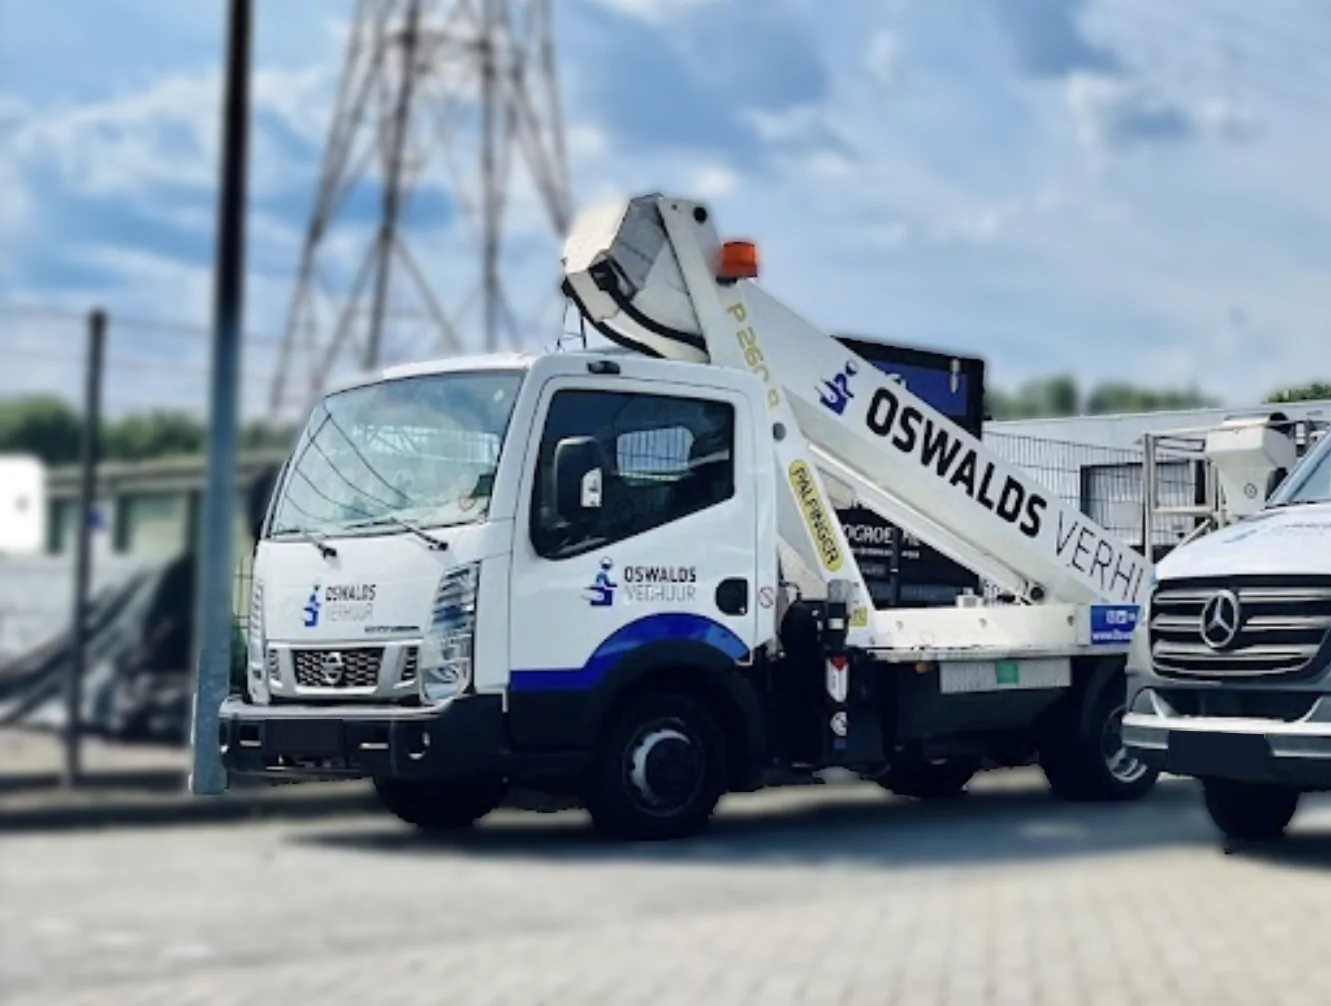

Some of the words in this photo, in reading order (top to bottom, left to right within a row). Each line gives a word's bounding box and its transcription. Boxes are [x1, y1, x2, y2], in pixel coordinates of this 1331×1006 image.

[866, 387, 1047, 538] OSWALDS
[792, 467, 839, 564] PALFINGER
[624, 565, 696, 583] OSWALDS
